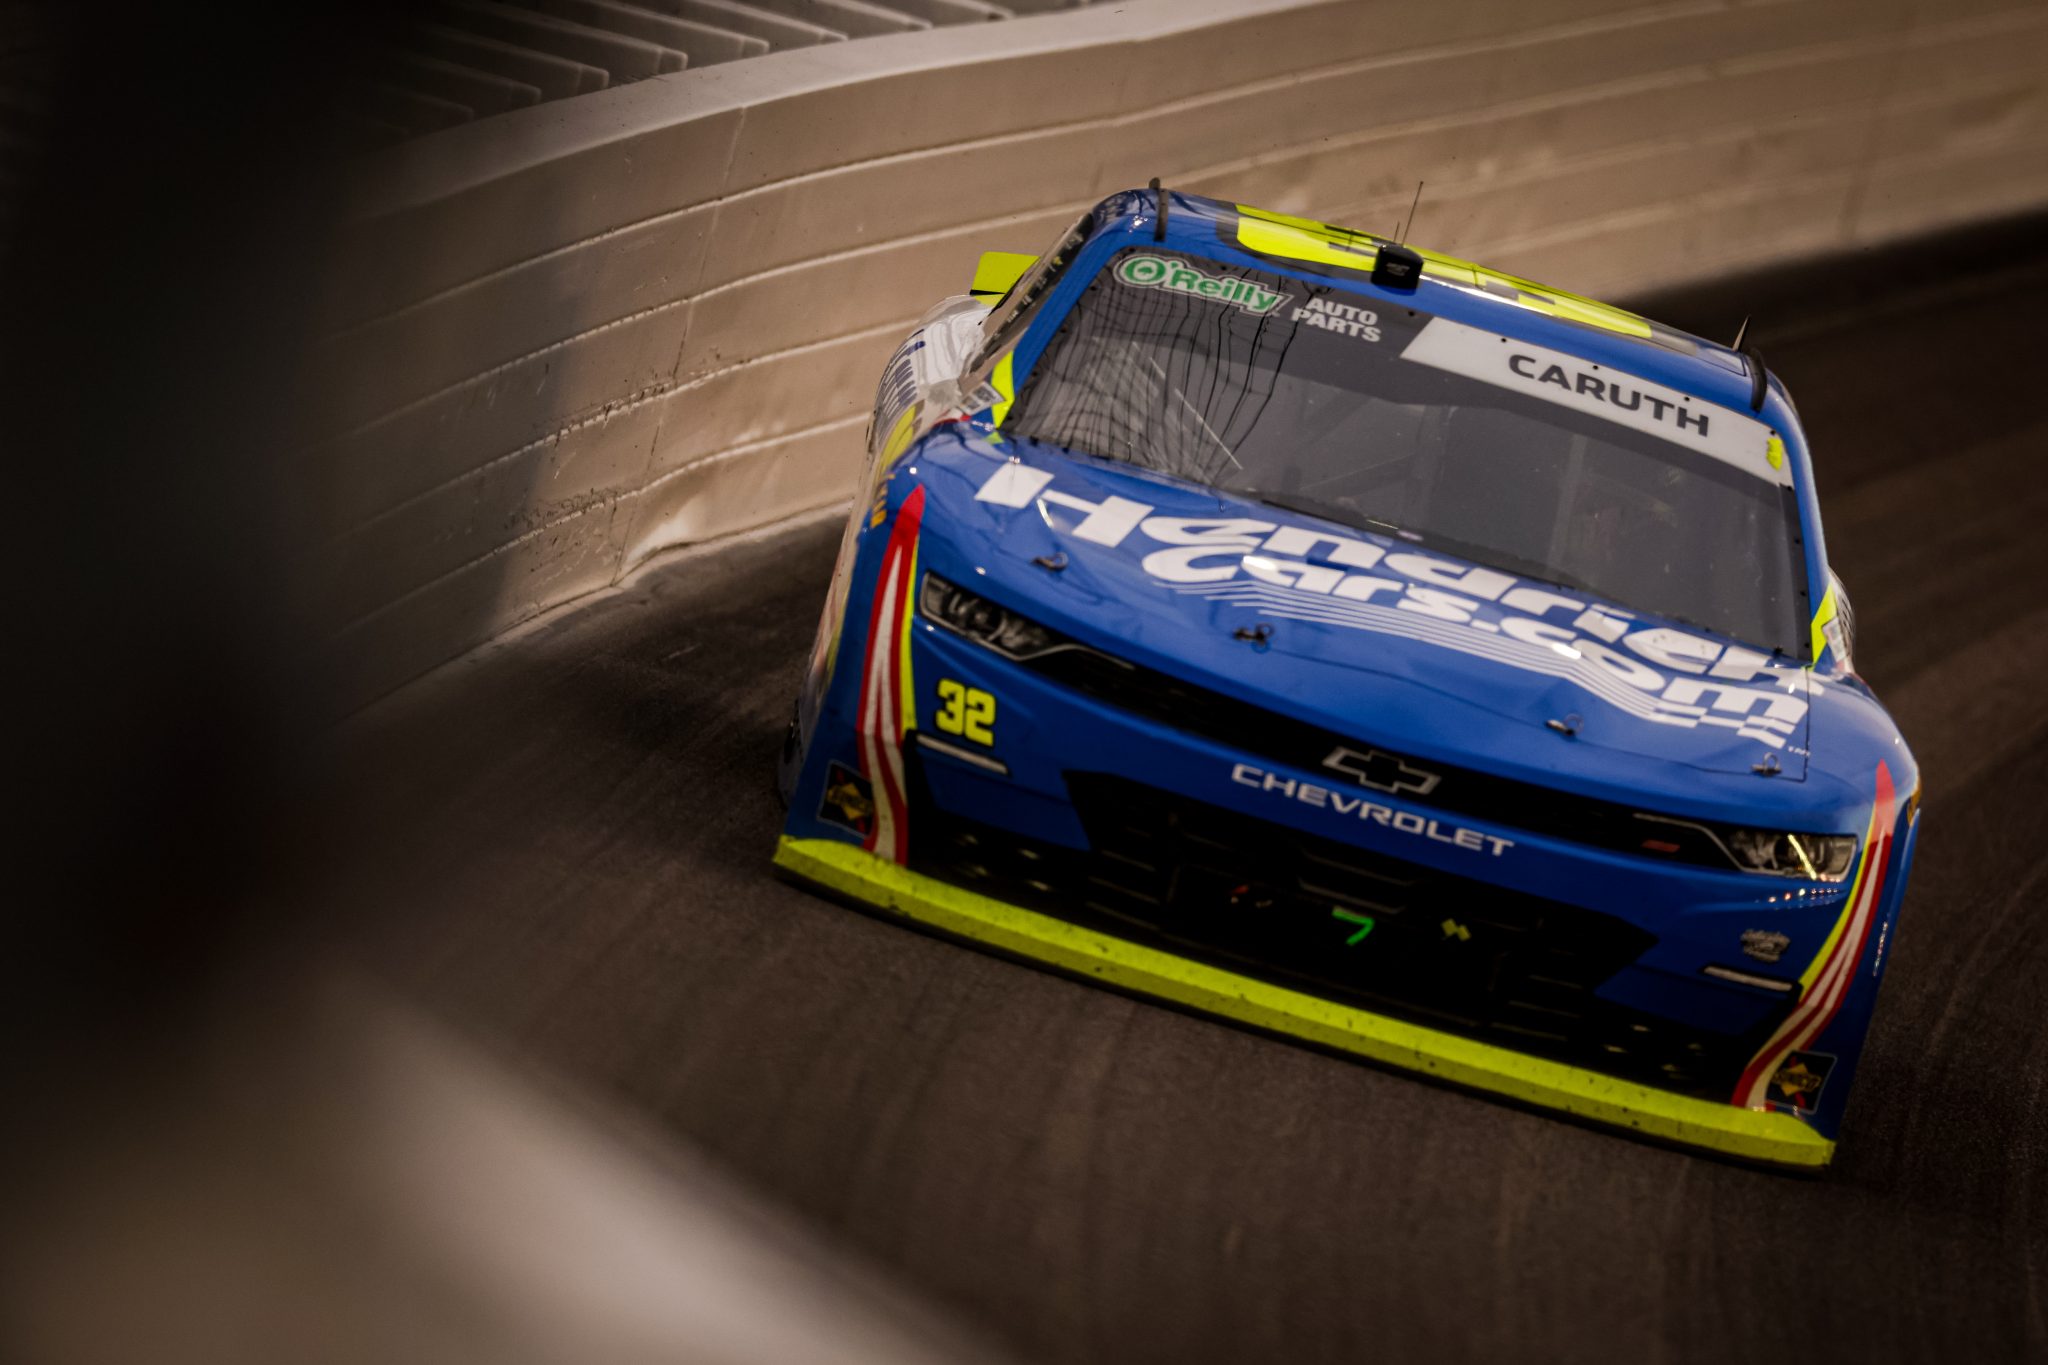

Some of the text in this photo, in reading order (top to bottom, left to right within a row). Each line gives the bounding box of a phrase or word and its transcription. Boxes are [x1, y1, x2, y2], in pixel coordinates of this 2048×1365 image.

[1122, 256, 1280, 311] O'Reilly
[1291, 308, 1381, 342] PARTS
[1305, 298, 1377, 326] AUTO
[1508, 354, 1709, 437] CARUTH
[935, 678, 997, 748] 32
[1231, 763, 1515, 857] CHEVROLET
[1331, 905, 1375, 946] 7
